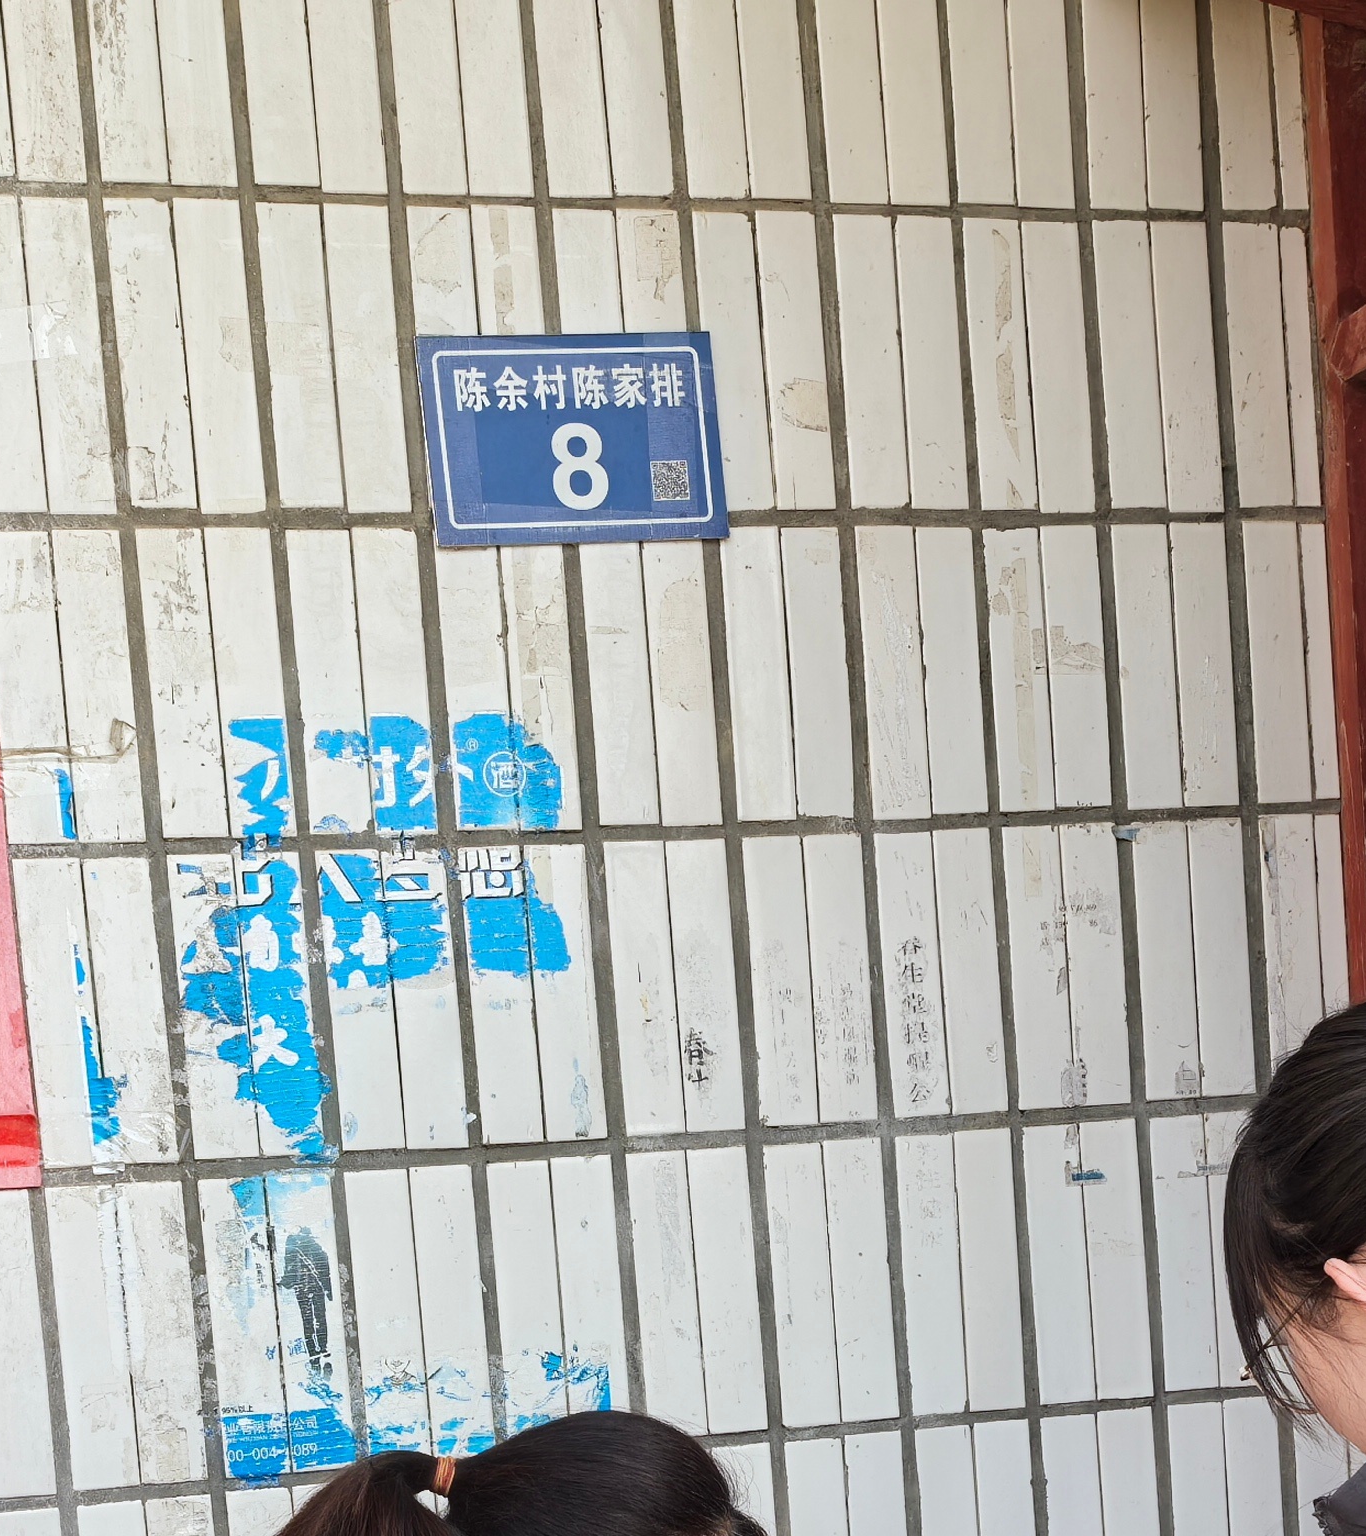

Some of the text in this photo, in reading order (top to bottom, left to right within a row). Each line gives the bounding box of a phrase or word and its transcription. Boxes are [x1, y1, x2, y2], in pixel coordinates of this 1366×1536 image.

[453, 362, 686, 412] 陈余村陈家排
[550, 422, 609, 511] 8
[227, 1443, 319, 1463] 00-004-089
